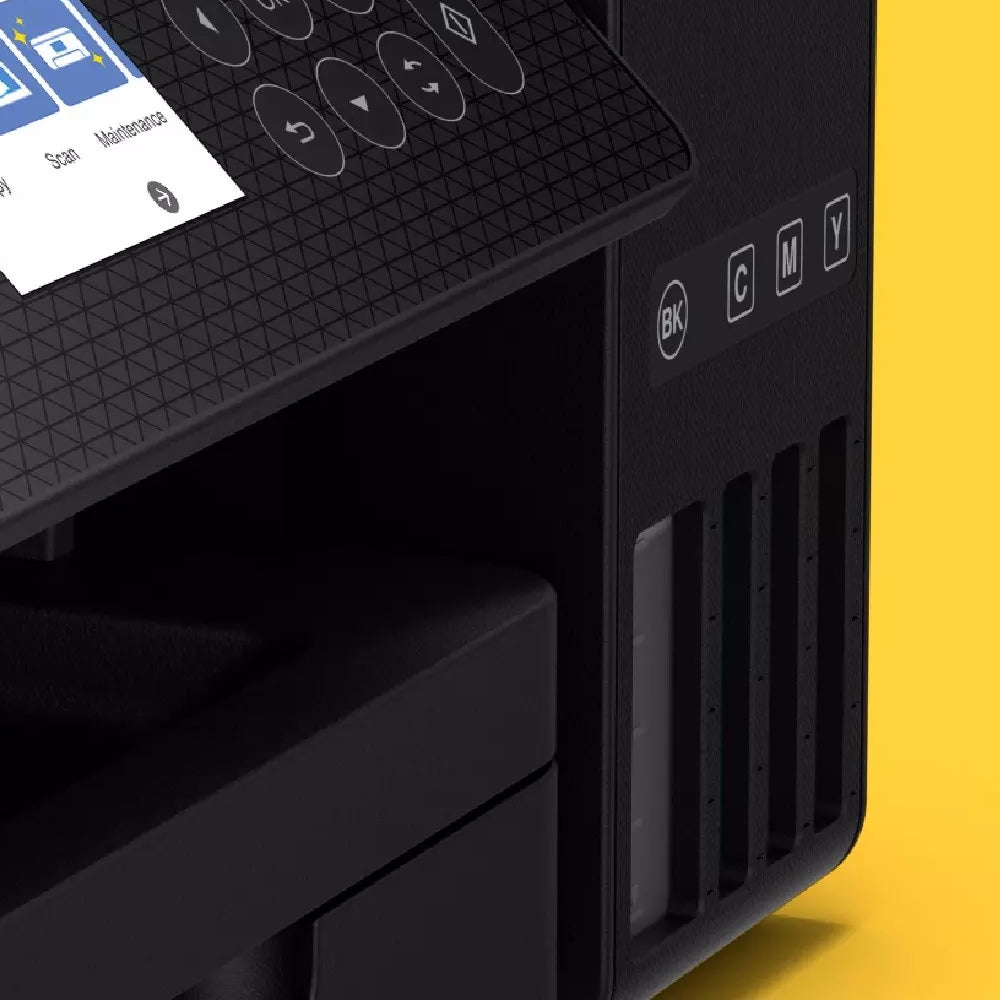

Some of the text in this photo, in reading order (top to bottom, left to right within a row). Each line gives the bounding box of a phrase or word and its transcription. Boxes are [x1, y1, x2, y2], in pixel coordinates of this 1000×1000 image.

[44, 148, 81, 170] Scan
[93, 111, 168, 148] Maintenance
[661, 212, 843, 340] BK C M Y
